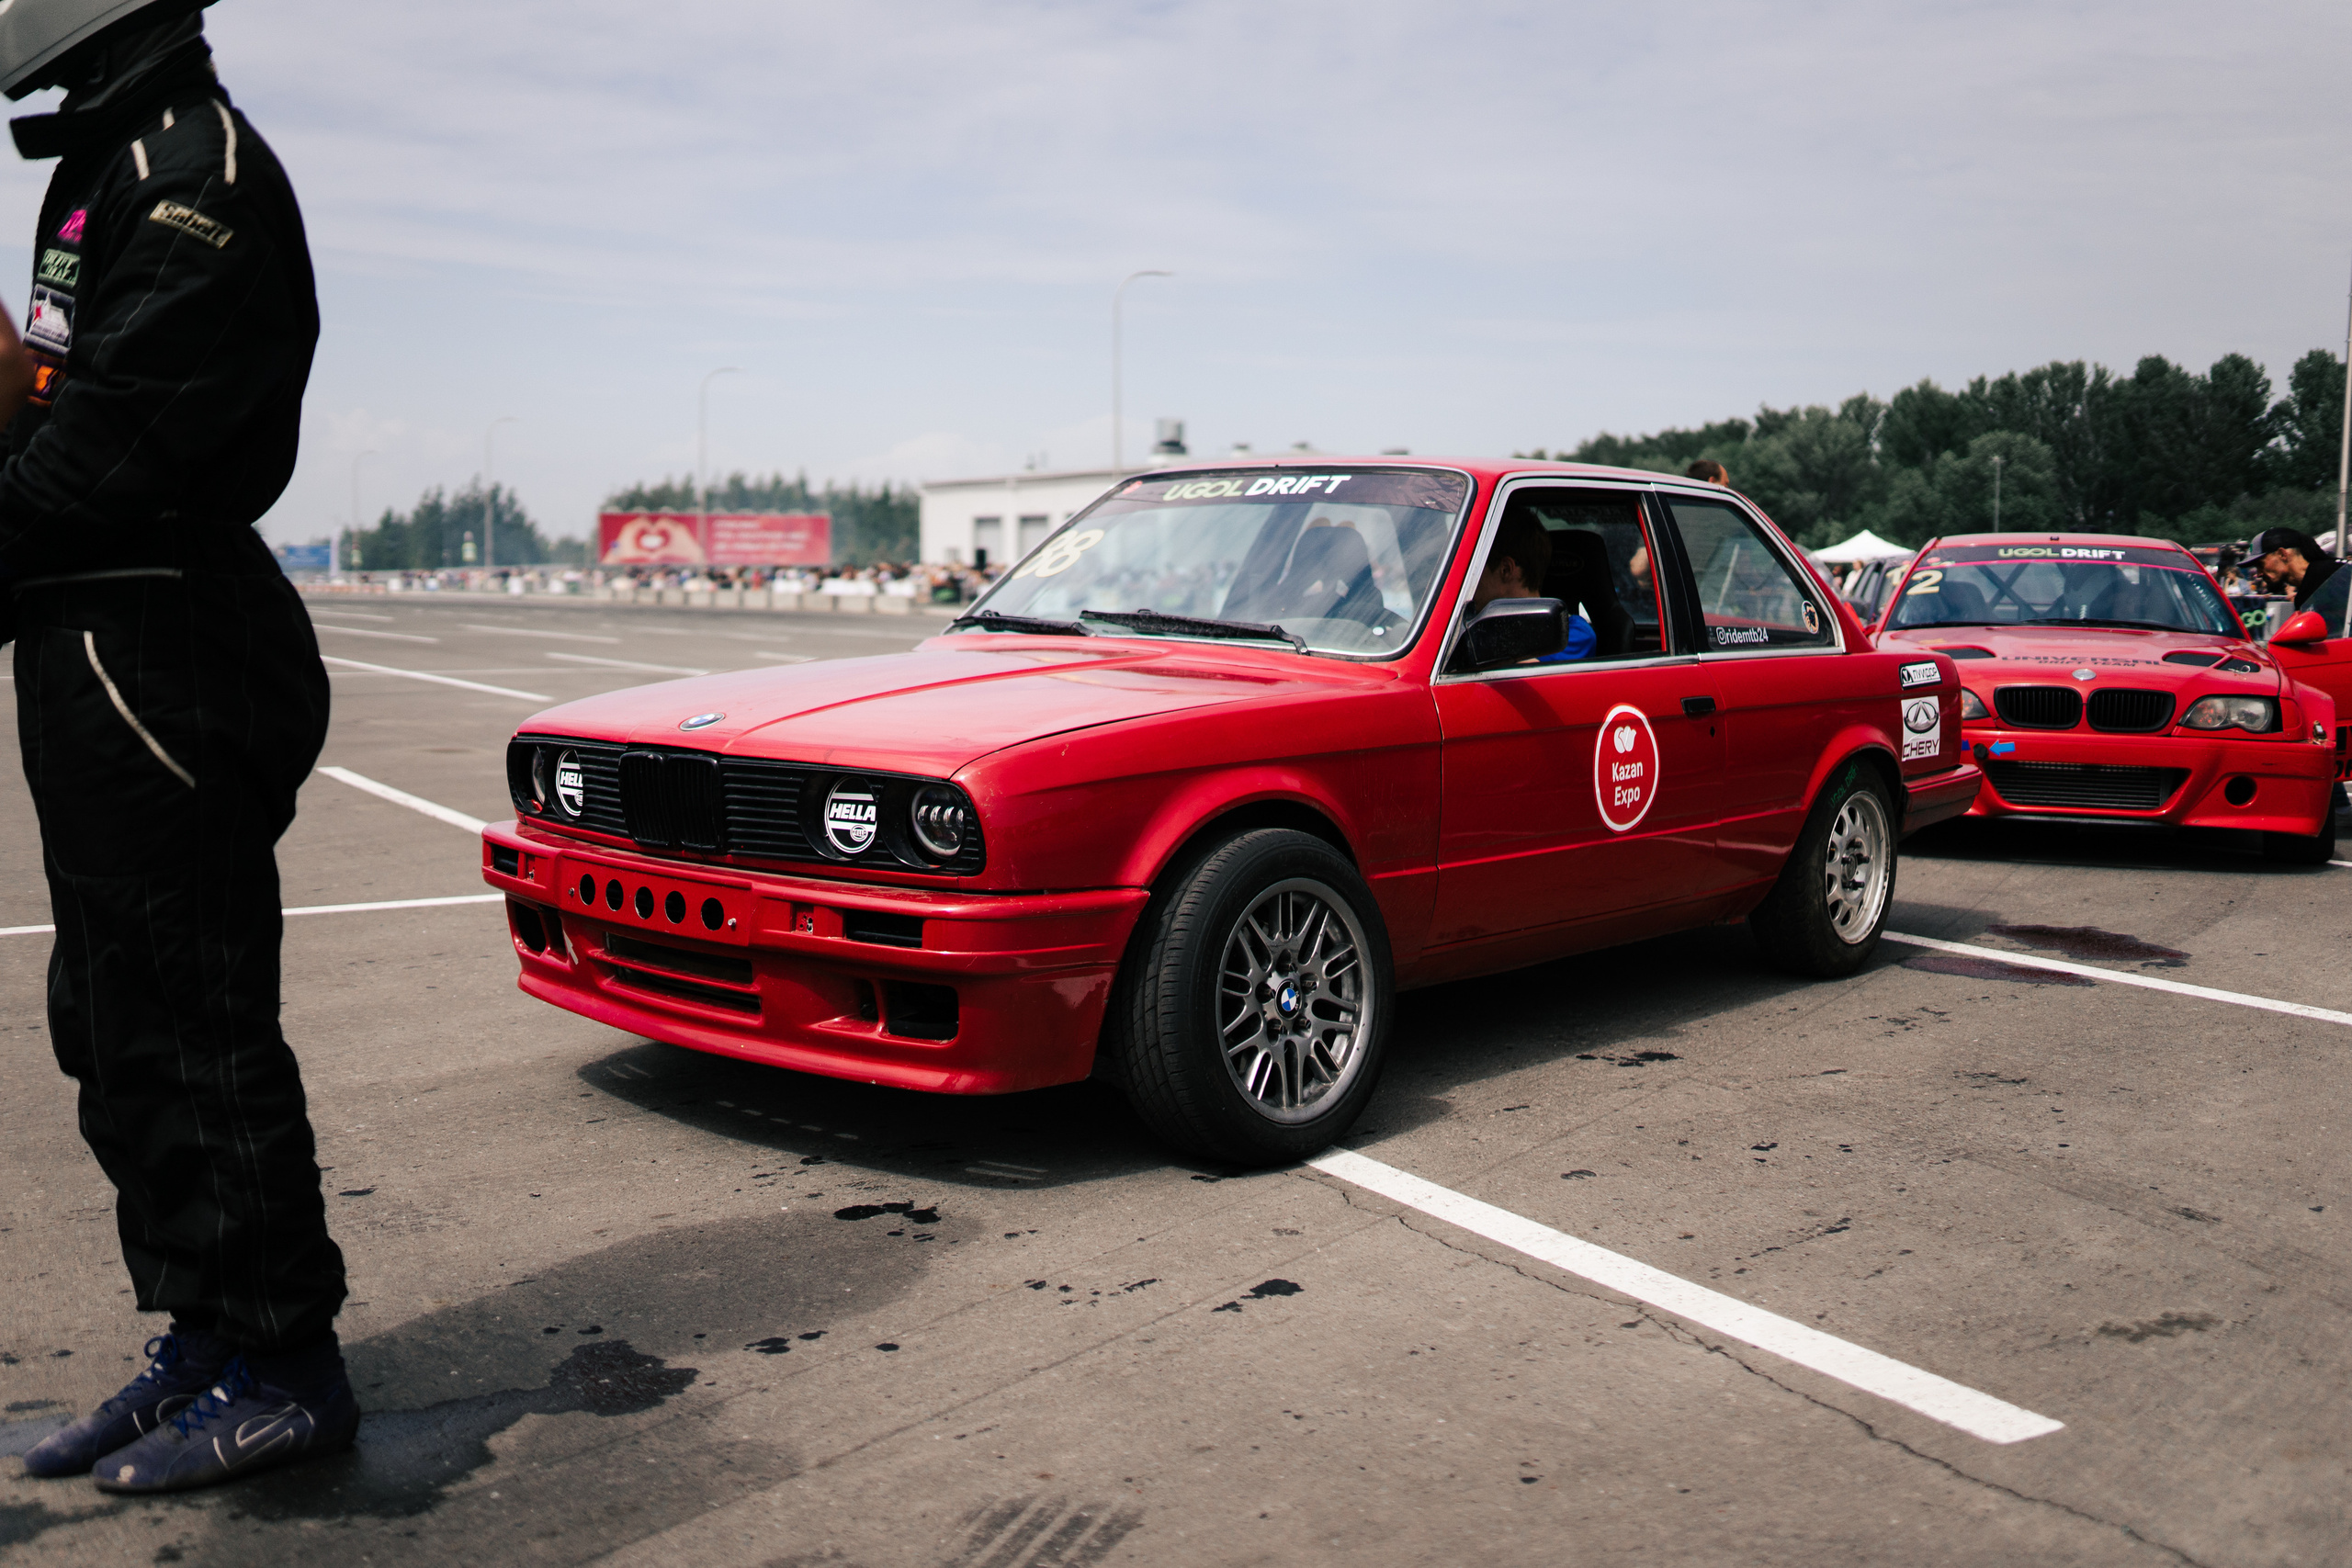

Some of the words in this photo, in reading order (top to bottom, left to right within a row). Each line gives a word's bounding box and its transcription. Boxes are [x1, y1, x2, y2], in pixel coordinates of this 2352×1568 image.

[2001, 656, 2172, 667] UNIVERSAL
[1902, 738, 1939, 759] CHERY
[560, 771, 583, 788] HELL
[1611, 761, 1644, 783] Kazan
[1614, 785, 1641, 808] Expo
[829, 802, 876, 822] HELLA
